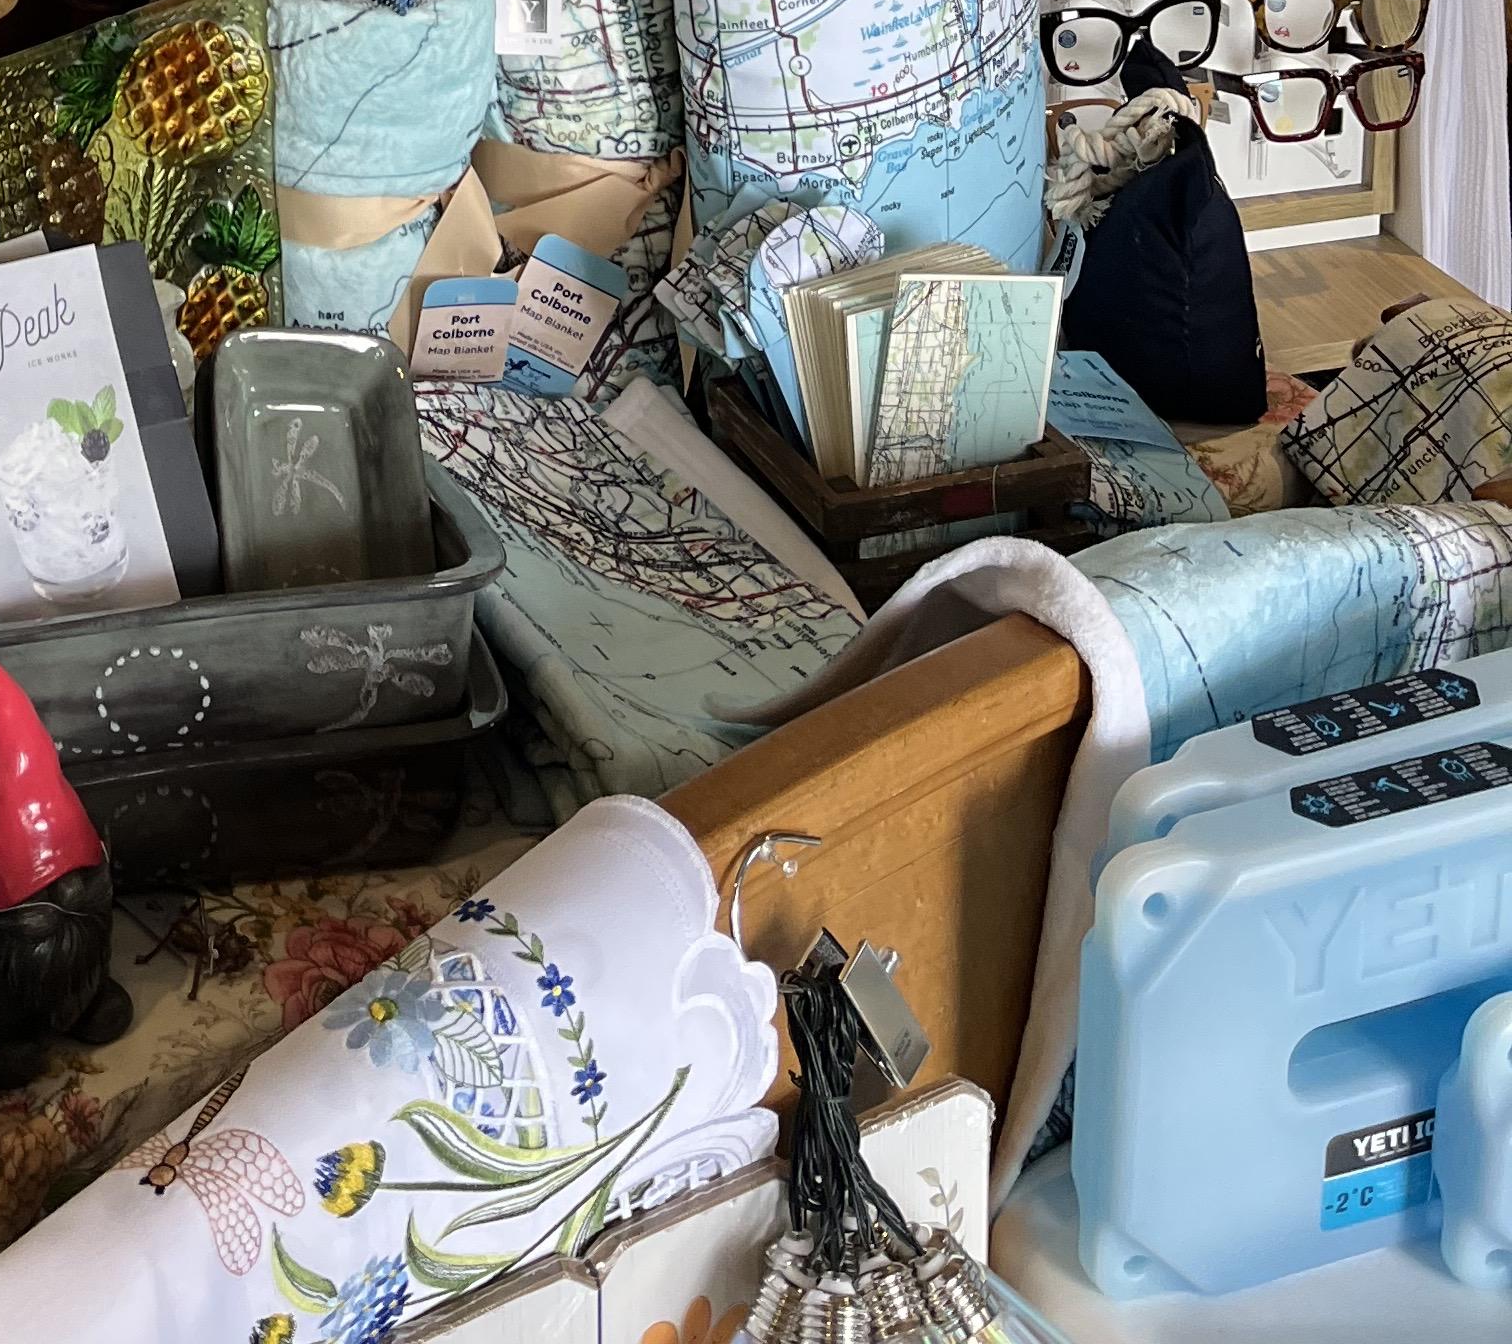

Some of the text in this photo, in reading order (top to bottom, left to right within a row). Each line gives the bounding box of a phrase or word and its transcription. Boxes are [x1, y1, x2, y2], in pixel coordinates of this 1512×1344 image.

[520, 0, 540, 24] Y
[776, 150, 833, 167] Burnaby
[732, 171, 774, 184] Beach
[880, 200, 902, 213] rocky
[552, 281, 584, 305] Port
[530, 288, 592, 326] Colborne
[317, 309, 345, 323] hard
[450, 314, 481, 326] Port
[520, 304, 585, 342] Map Blanket
[432, 327, 495, 342] Colborne
[427, 344, 495, 358] Map Blanket
[1262, 862, 1512, 999] YET
[1351, 1125, 1411, 1158] YETI
